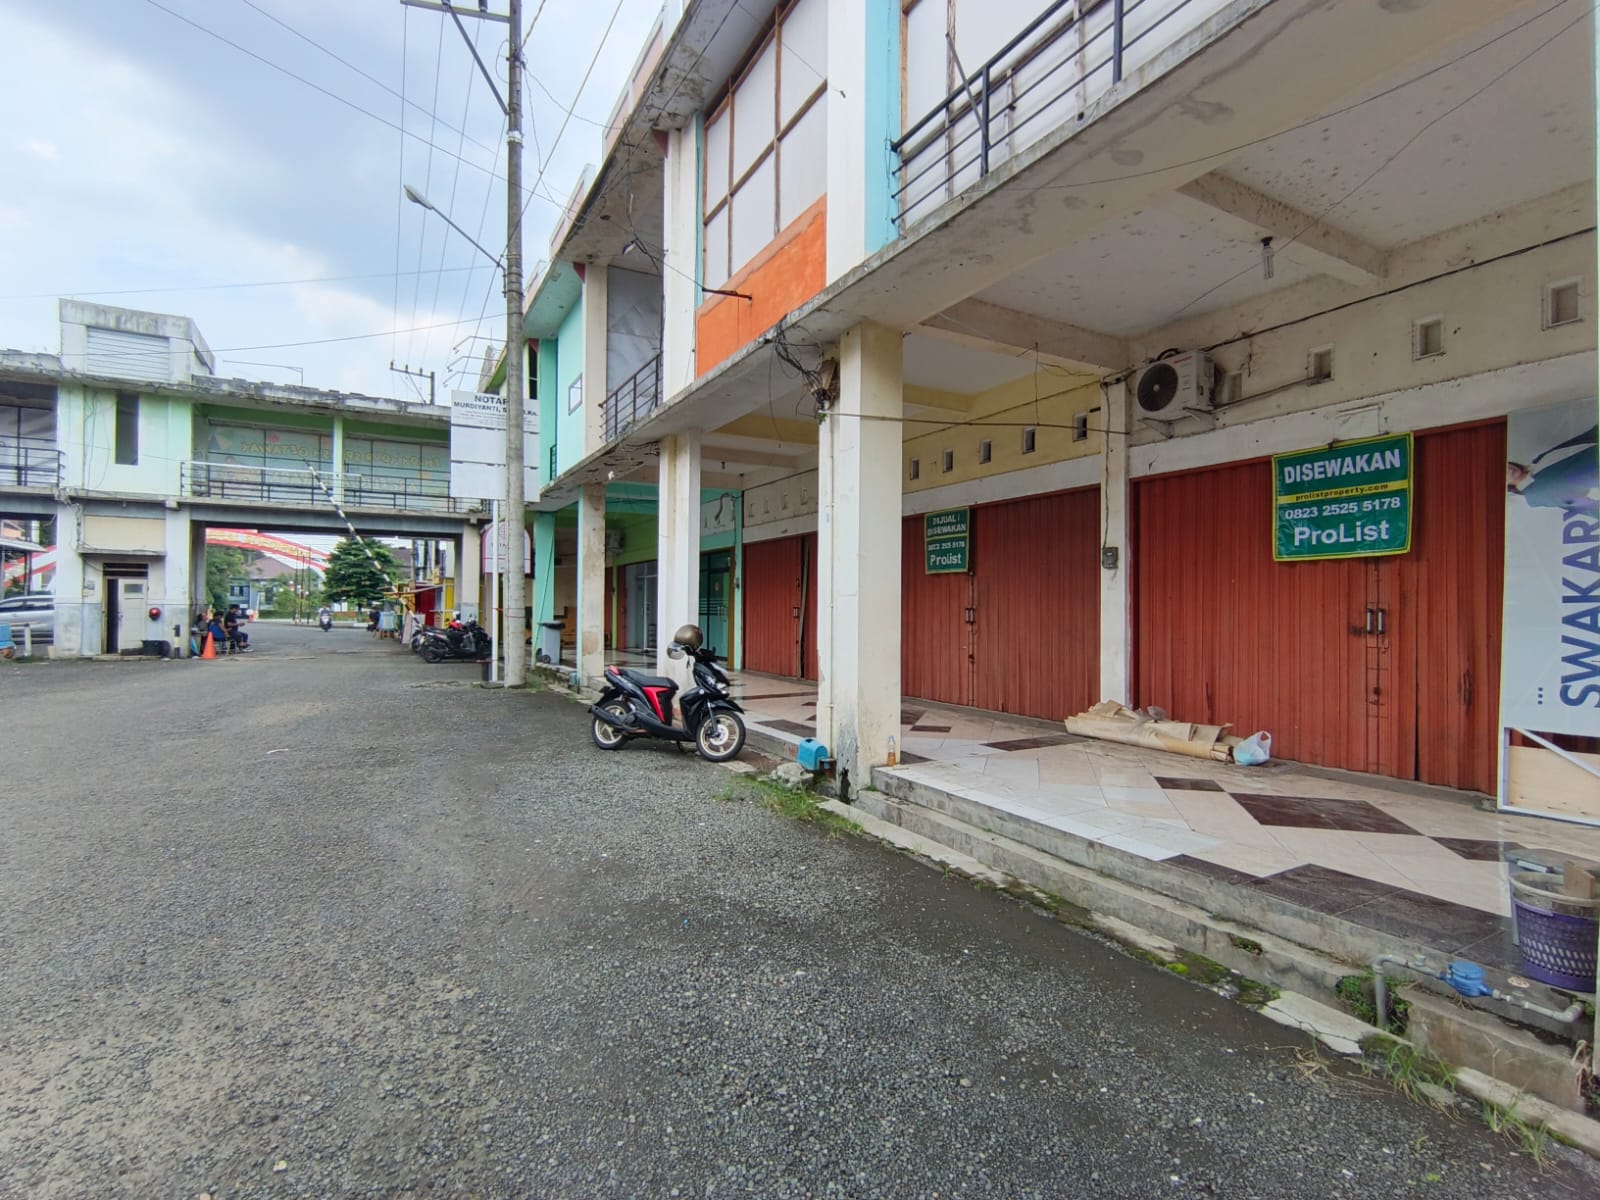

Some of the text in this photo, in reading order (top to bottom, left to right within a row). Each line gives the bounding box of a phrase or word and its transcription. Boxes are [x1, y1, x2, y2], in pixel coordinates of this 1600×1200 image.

[1284, 449, 1401, 483] DISEWAKAN
[1295, 484, 1389, 501] prolistproperty.com
[1285, 497, 1400, 520] 0823 2525 5178
[1294, 520, 1390, 546] ProList
